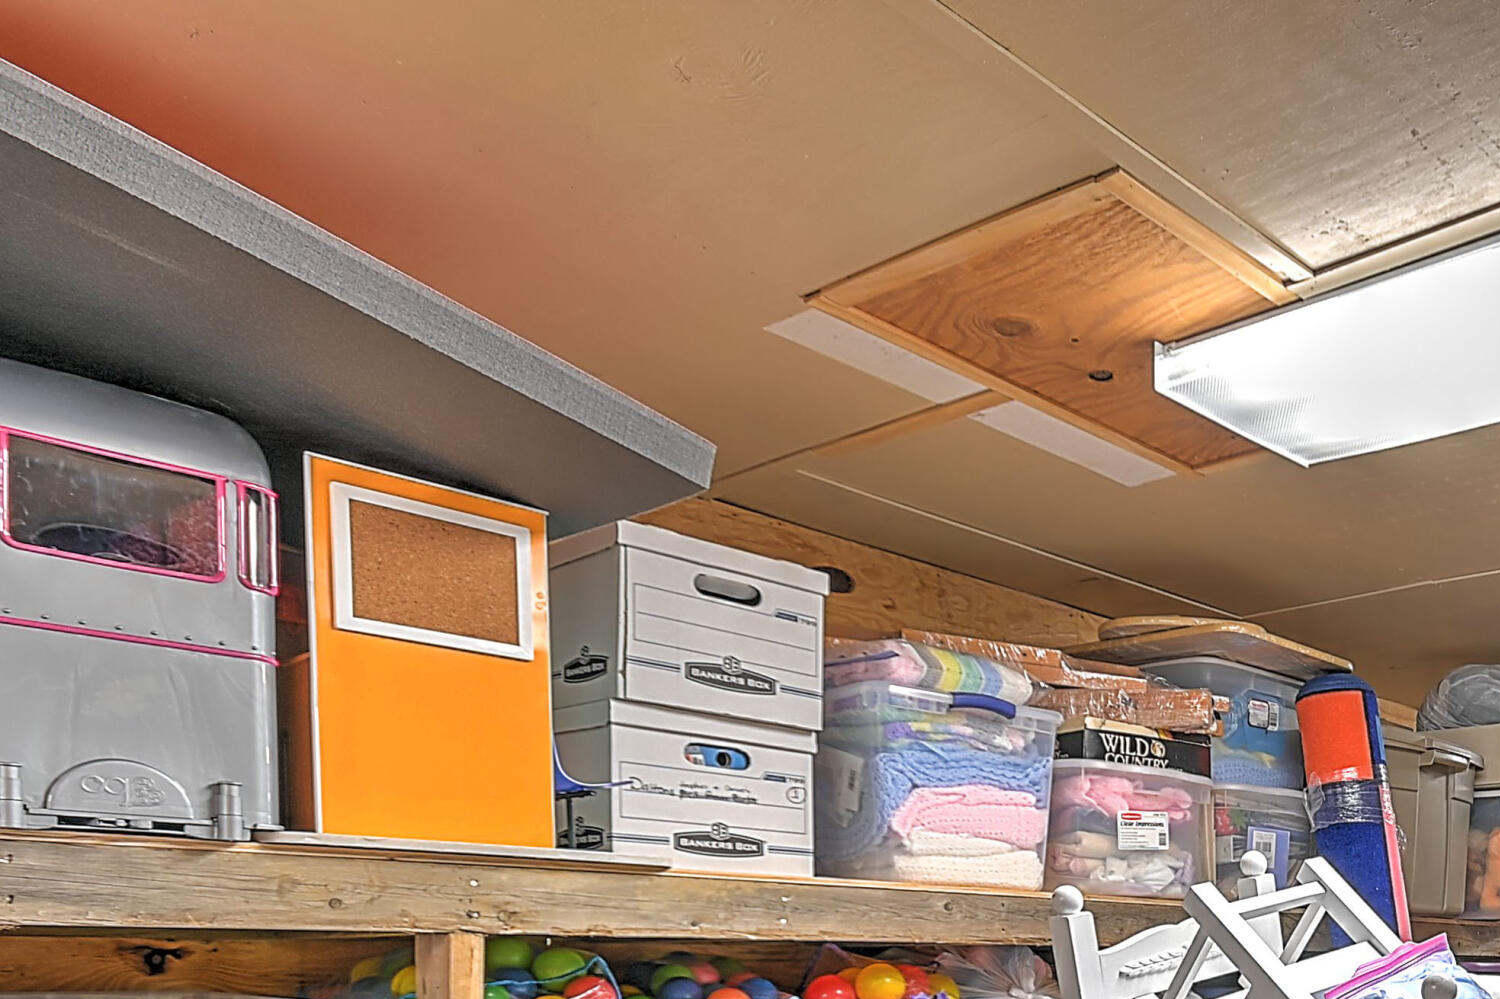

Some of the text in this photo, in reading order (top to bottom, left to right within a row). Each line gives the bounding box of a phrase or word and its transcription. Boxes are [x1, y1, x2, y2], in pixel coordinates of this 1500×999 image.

[690, 667, 770, 690] BANKERS BOX
[1099, 732, 1149, 757] WILD
[679, 837, 759, 852] BANKERS BOX
